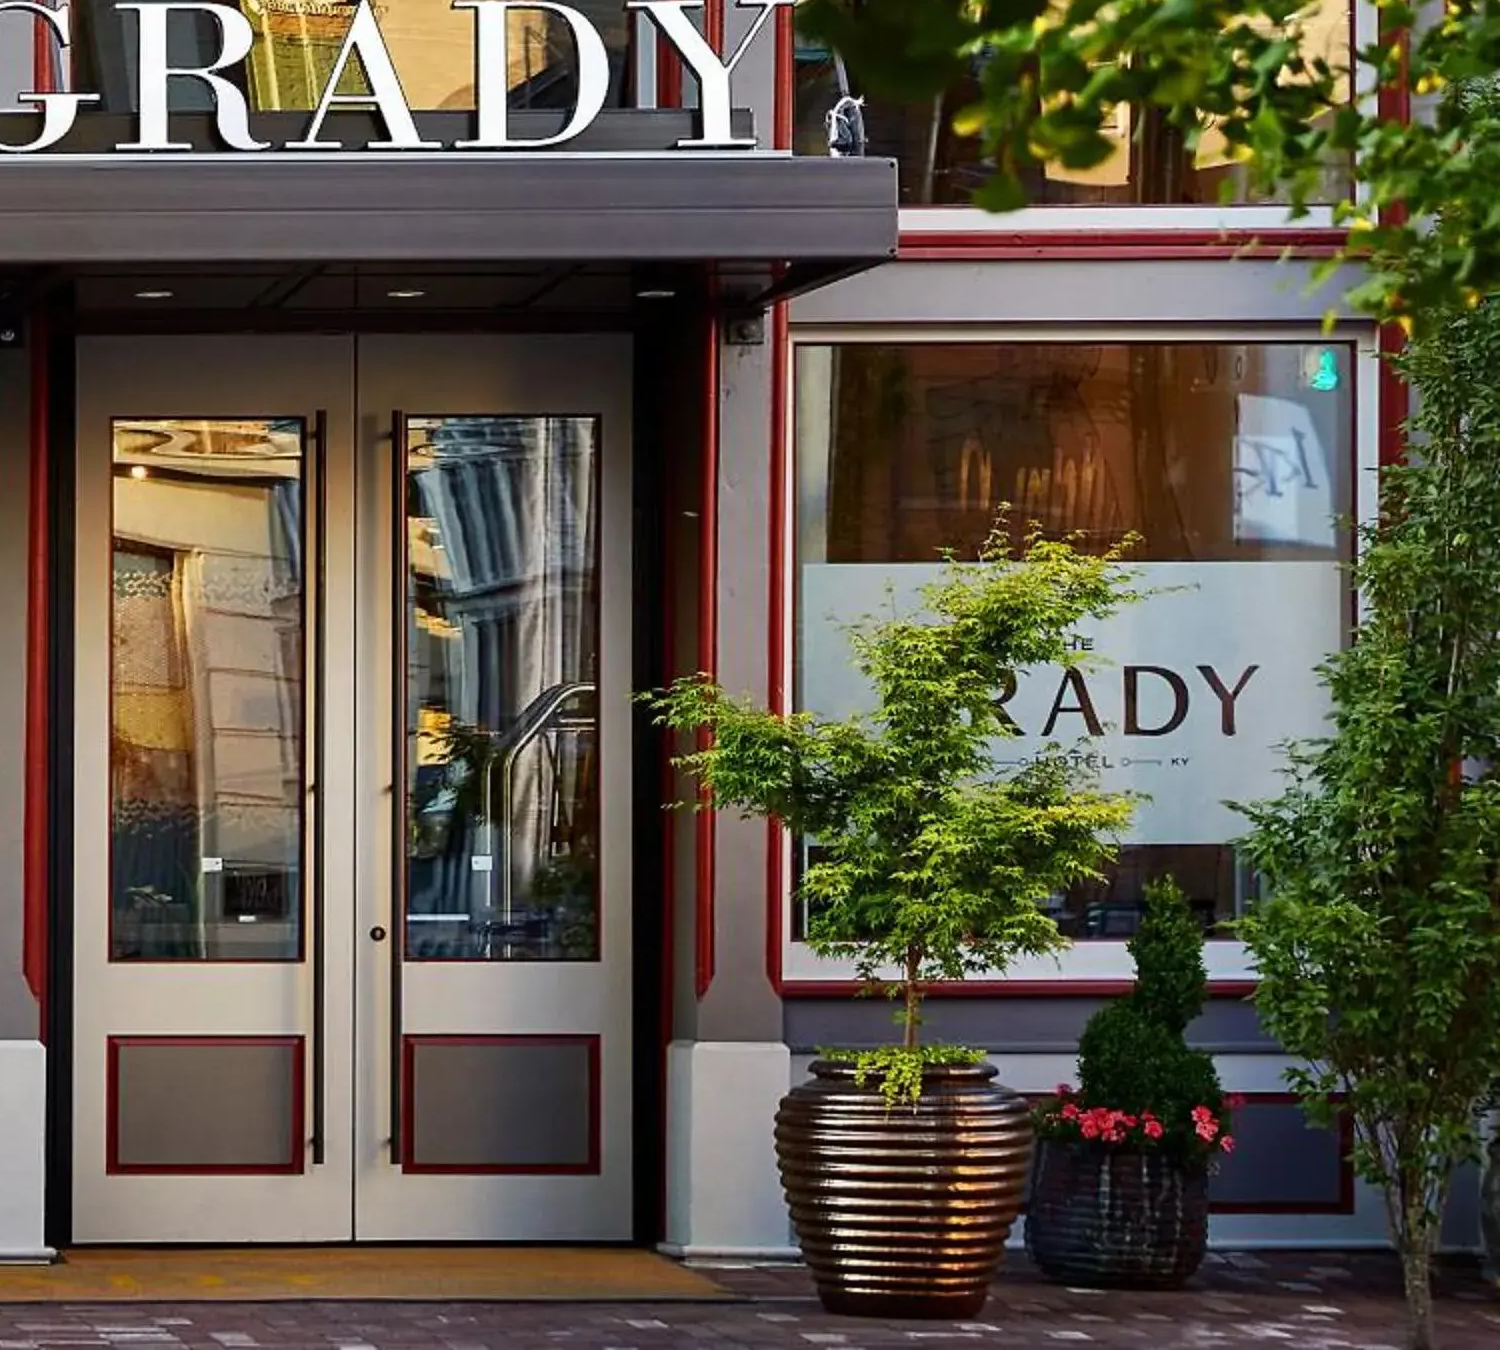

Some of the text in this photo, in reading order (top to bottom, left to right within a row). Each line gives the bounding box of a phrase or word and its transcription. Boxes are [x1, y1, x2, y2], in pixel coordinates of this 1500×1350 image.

[1063, 635, 1095, 650] HE
[989, 665, 1261, 737] RADY
[1171, 757, 1189, 766] KY
